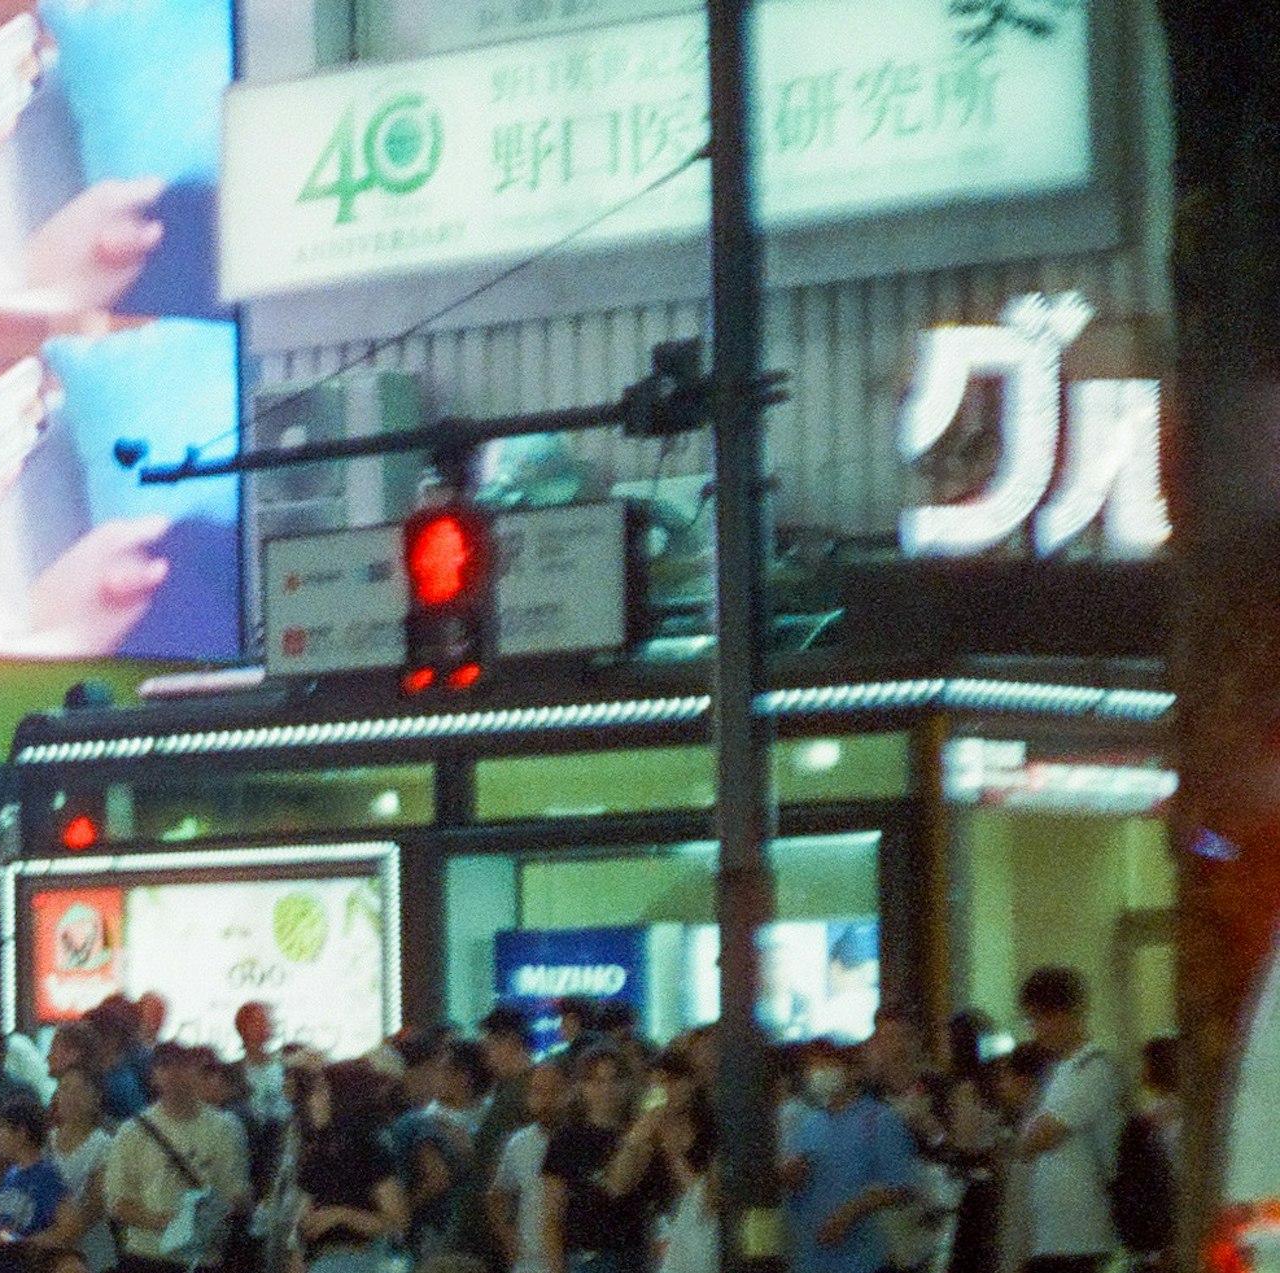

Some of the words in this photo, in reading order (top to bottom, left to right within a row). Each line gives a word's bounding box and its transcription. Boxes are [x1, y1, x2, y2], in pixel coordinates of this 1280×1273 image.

[295, 90, 444, 227] 40
[490, 48, 1002, 195] 野口医研究所
